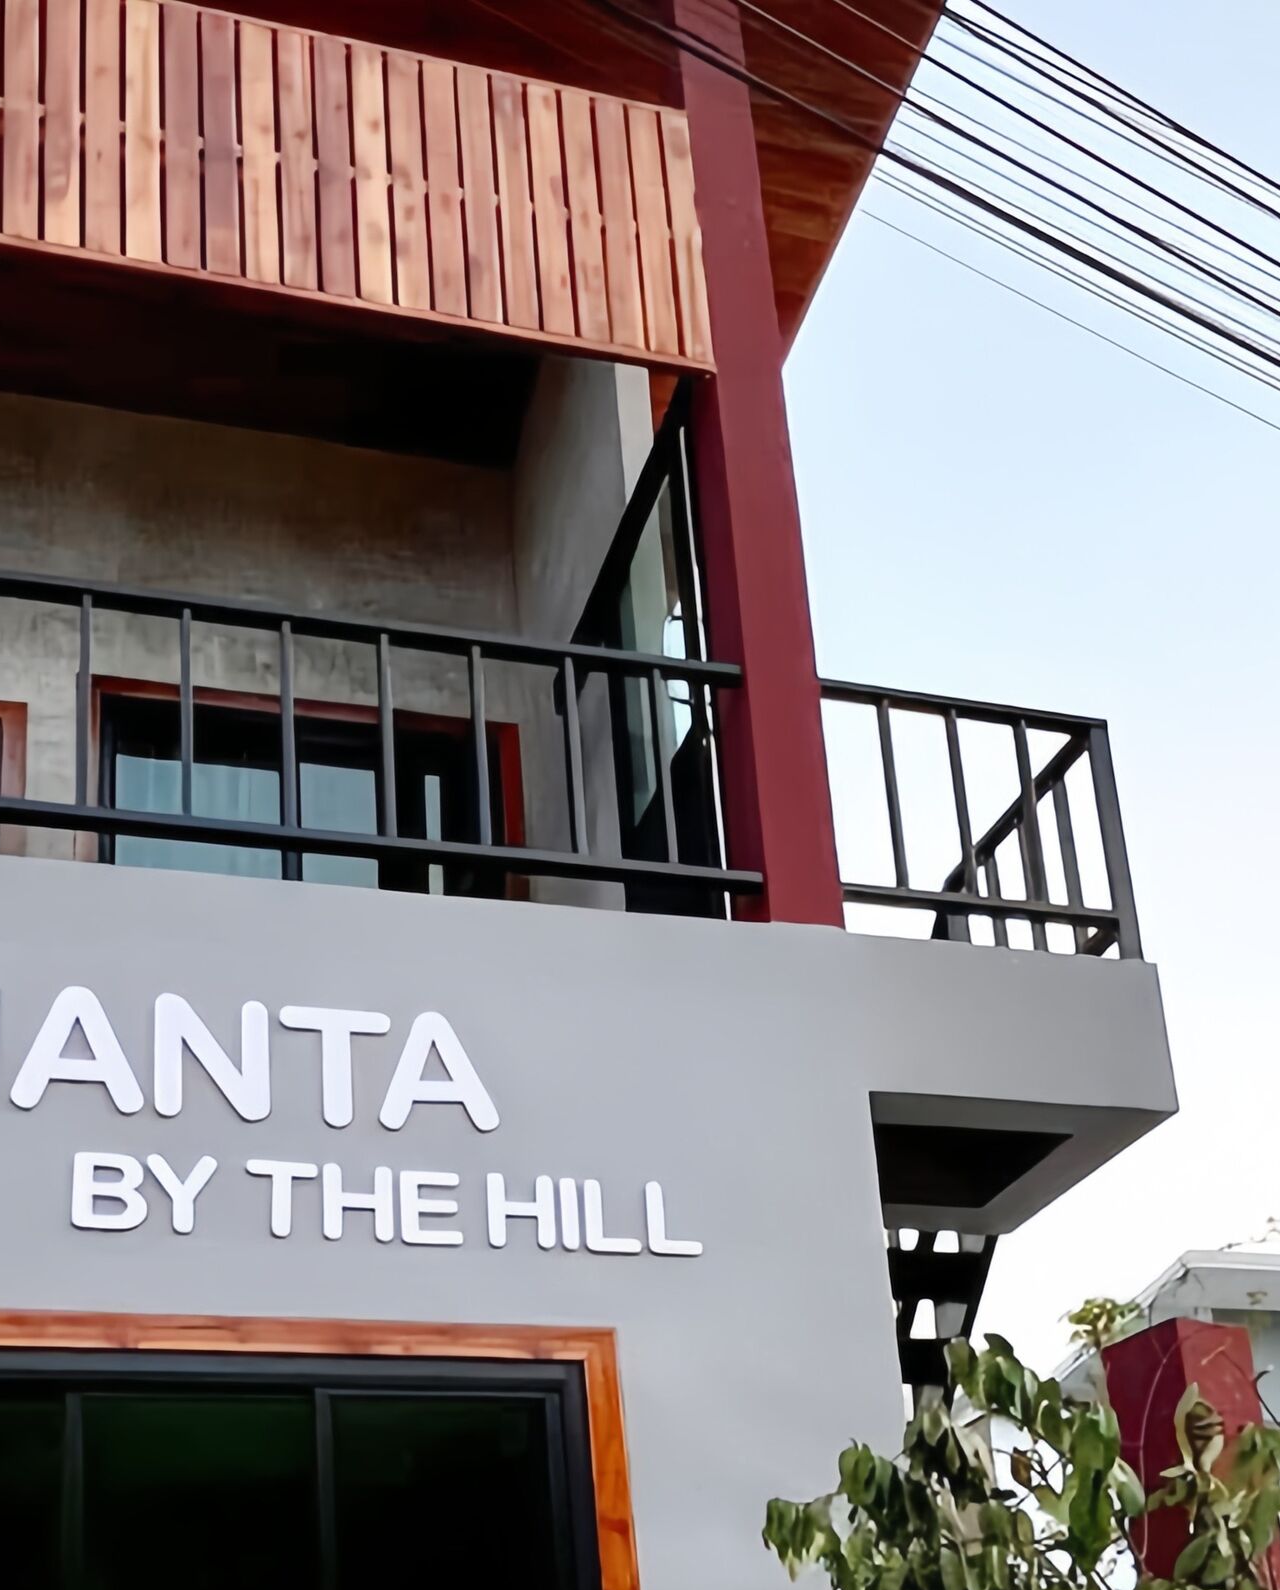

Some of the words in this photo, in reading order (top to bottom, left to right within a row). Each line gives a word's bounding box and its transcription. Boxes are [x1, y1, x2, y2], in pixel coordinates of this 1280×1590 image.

[69, 1150, 219, 1235] BY
[244, 1157, 465, 1247] THE
[485, 1171, 705, 1257] HILL
